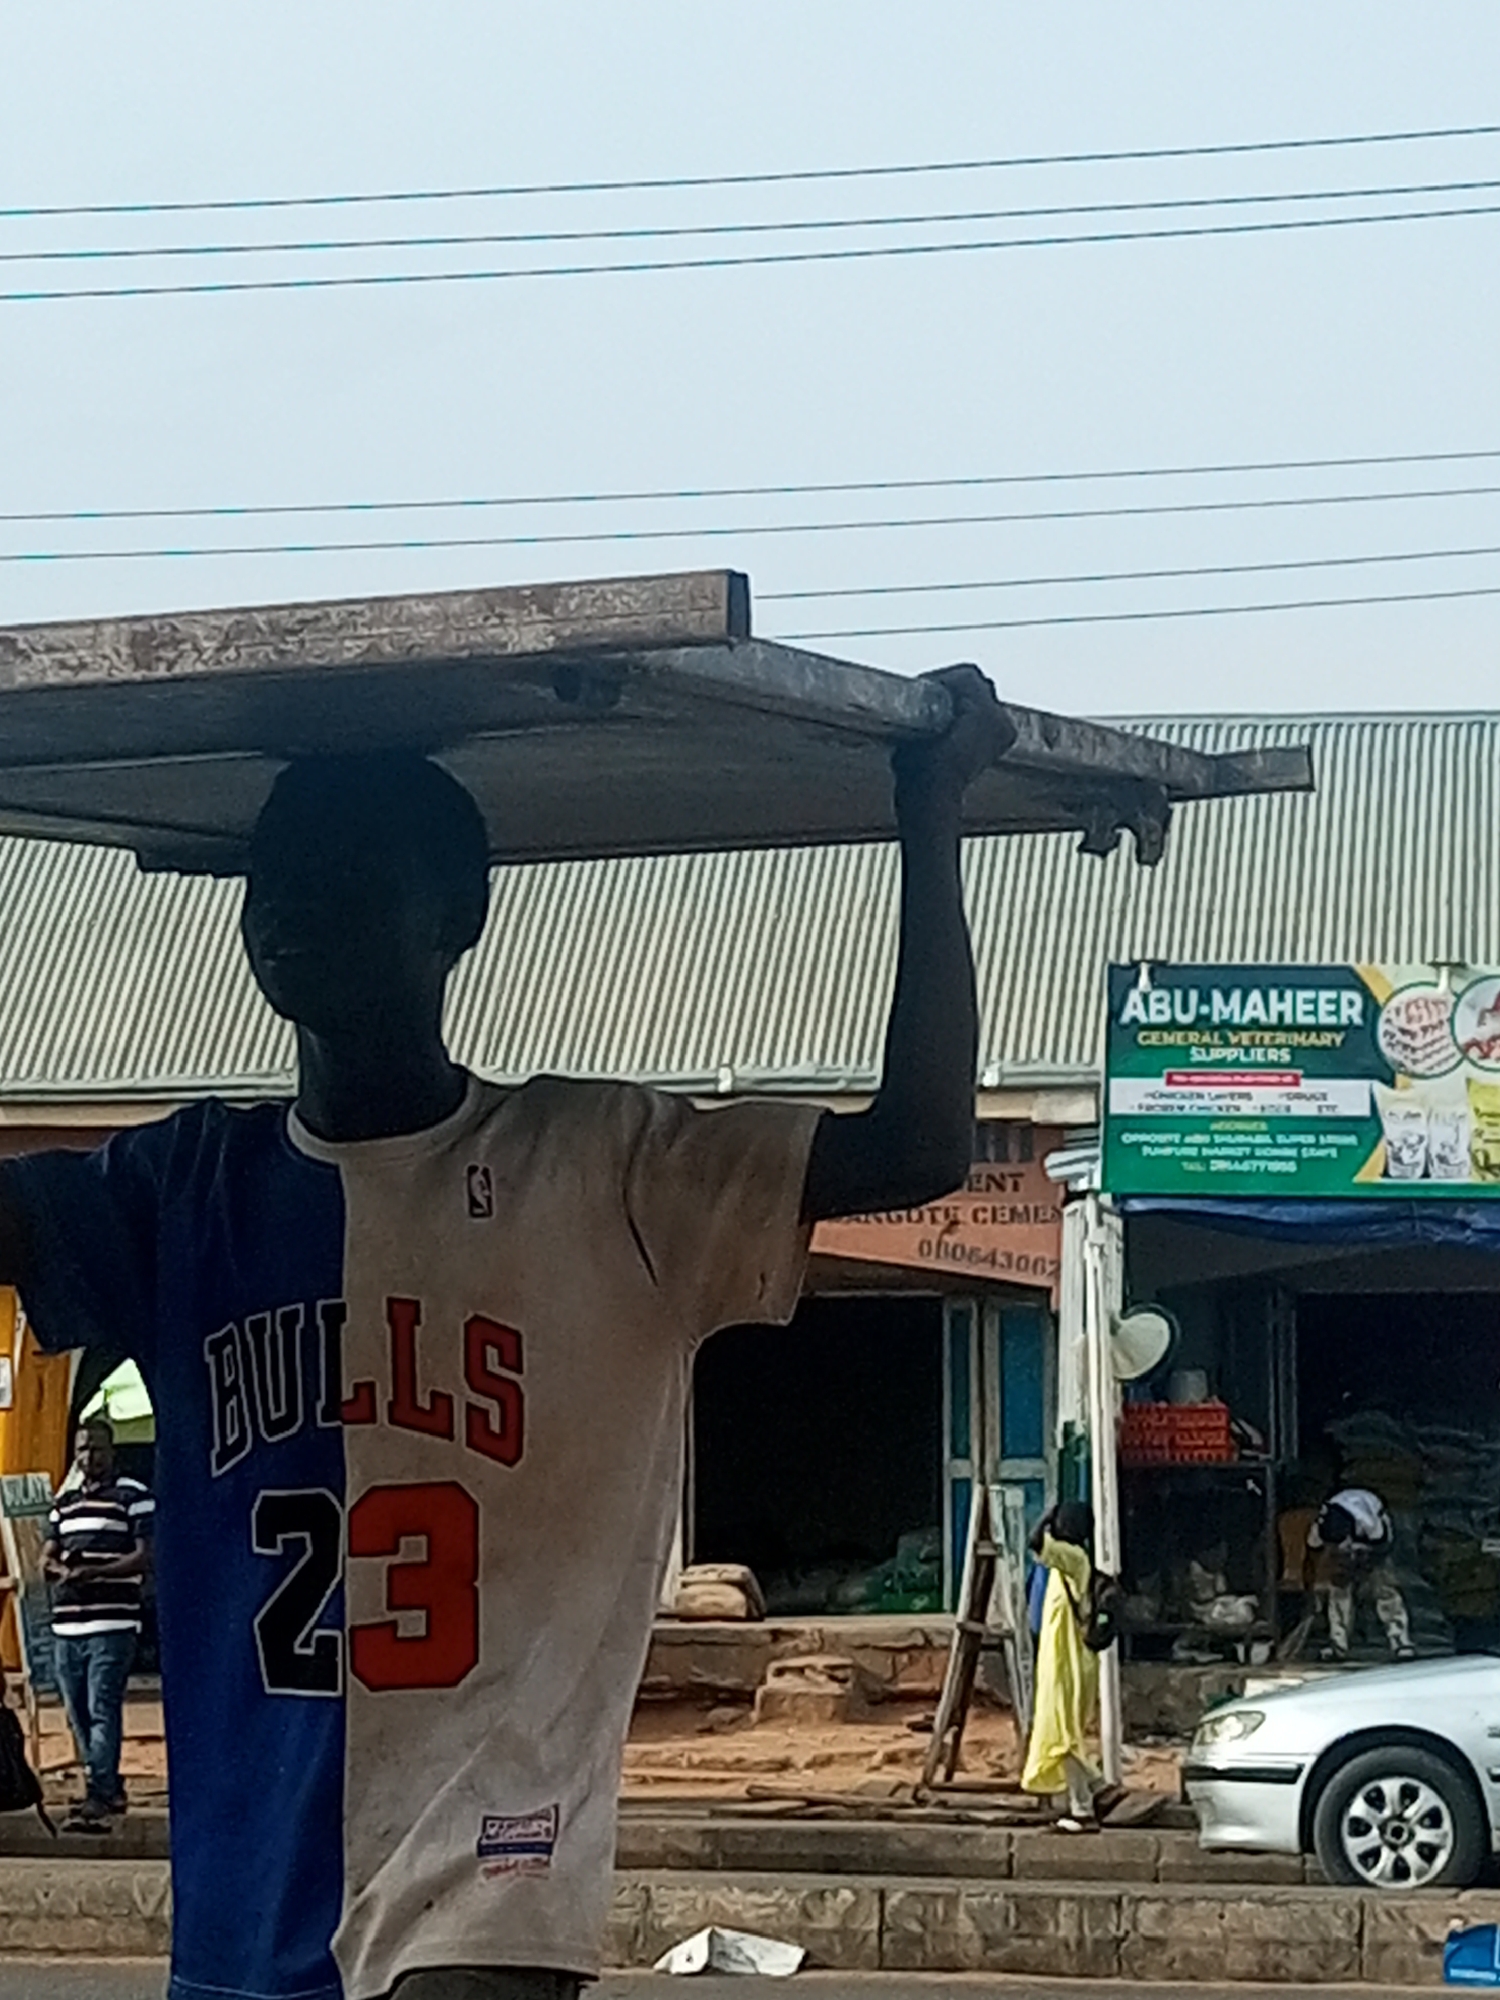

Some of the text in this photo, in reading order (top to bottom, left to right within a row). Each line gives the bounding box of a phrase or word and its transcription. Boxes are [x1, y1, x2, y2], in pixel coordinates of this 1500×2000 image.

[1119, 988, 1364, 1025] ABU-MAHEER
[1137, 1031, 1346, 1047] GENERAL VETERINARY
[1190, 1046, 1291, 1063] SUPPLIERS
[966, 1172, 1025, 1193] ENT
[971, 1204, 1063, 1225] CEMEN
[205, 1297, 524, 1477] BULLS
[252, 1480, 480, 1697] 23
